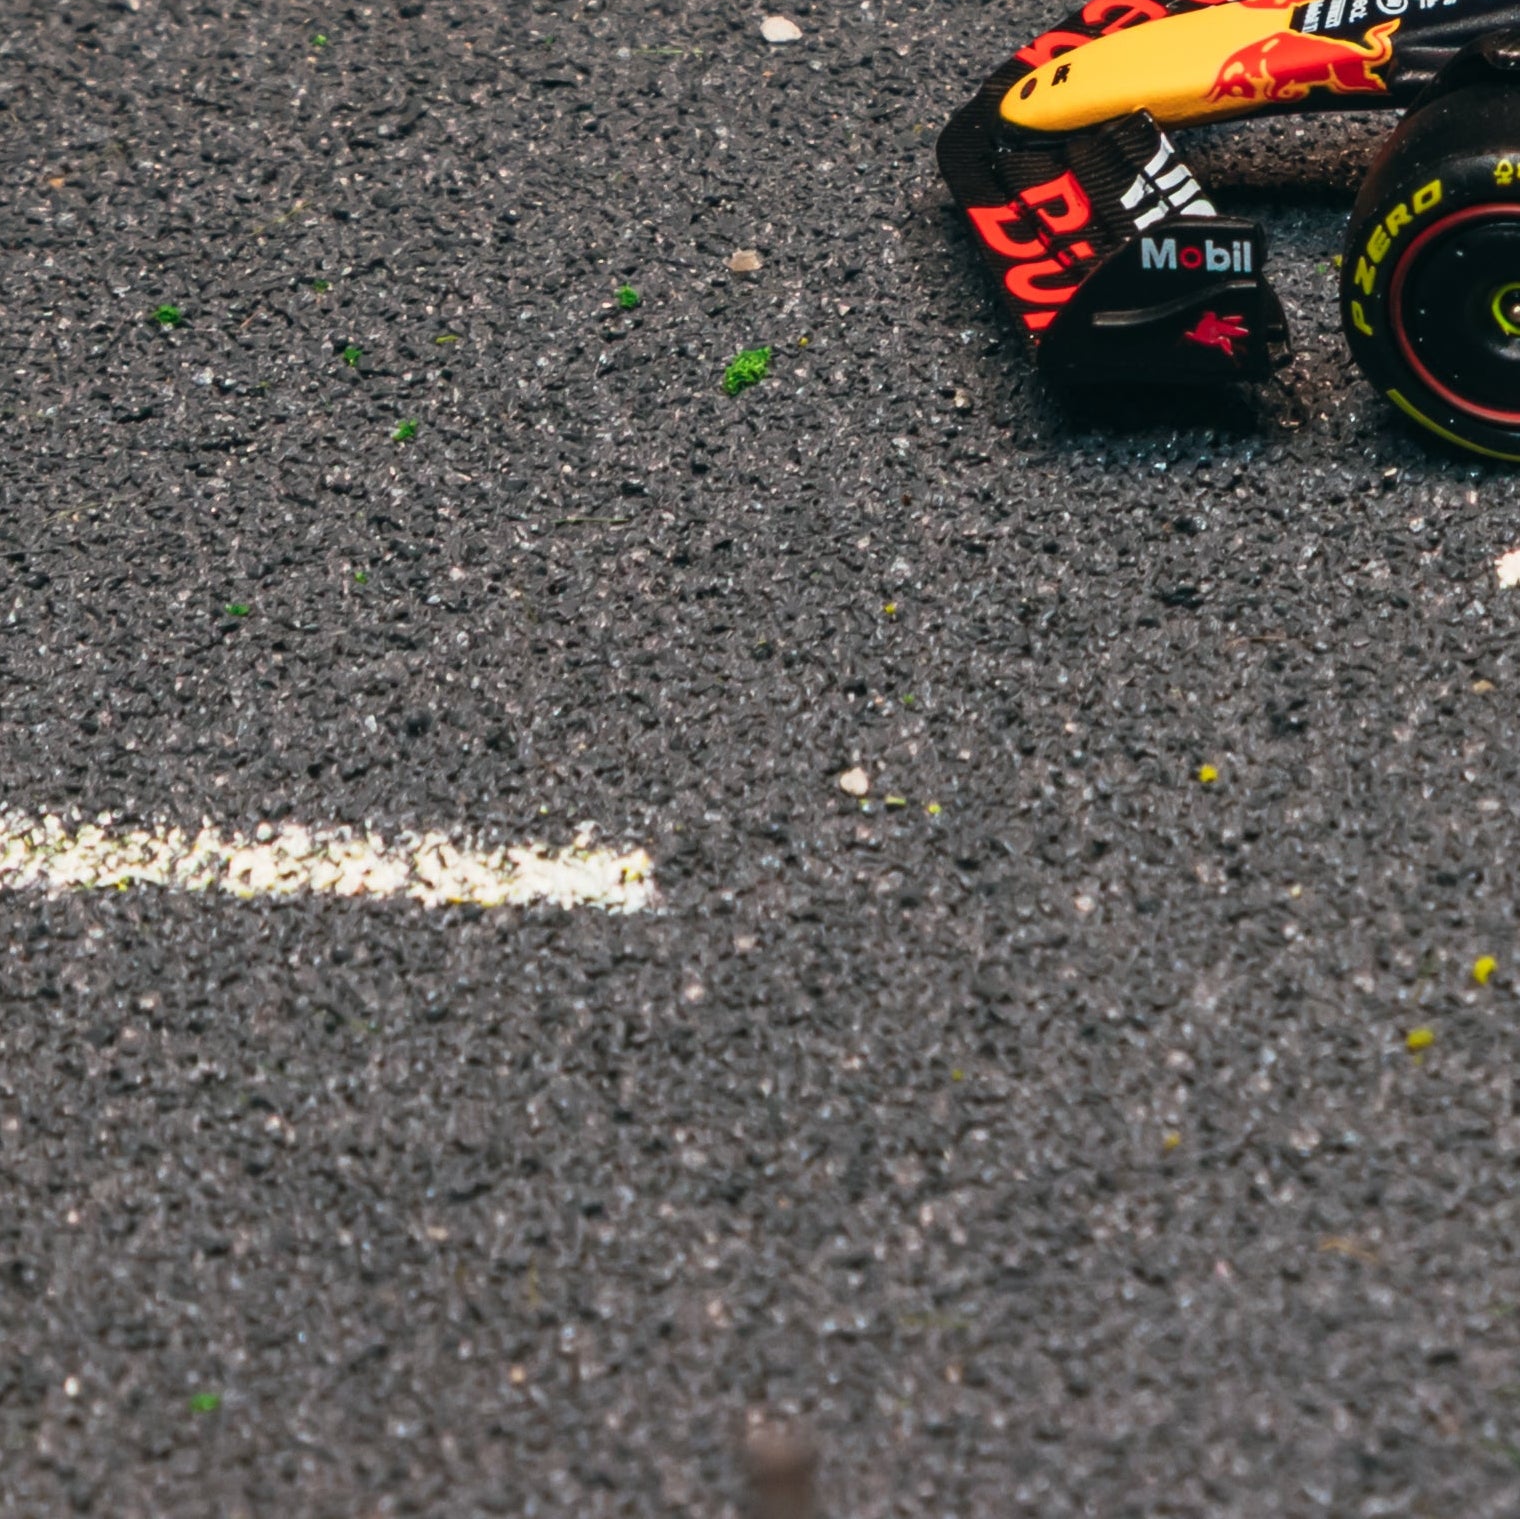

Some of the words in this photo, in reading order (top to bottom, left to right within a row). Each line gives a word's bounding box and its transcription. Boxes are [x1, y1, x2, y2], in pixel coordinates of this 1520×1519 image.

[967, 169, 1096, 346] Bu
[1141, 237, 1253, 273] Mobil
[1354, 179, 1443, 296] ZERO
